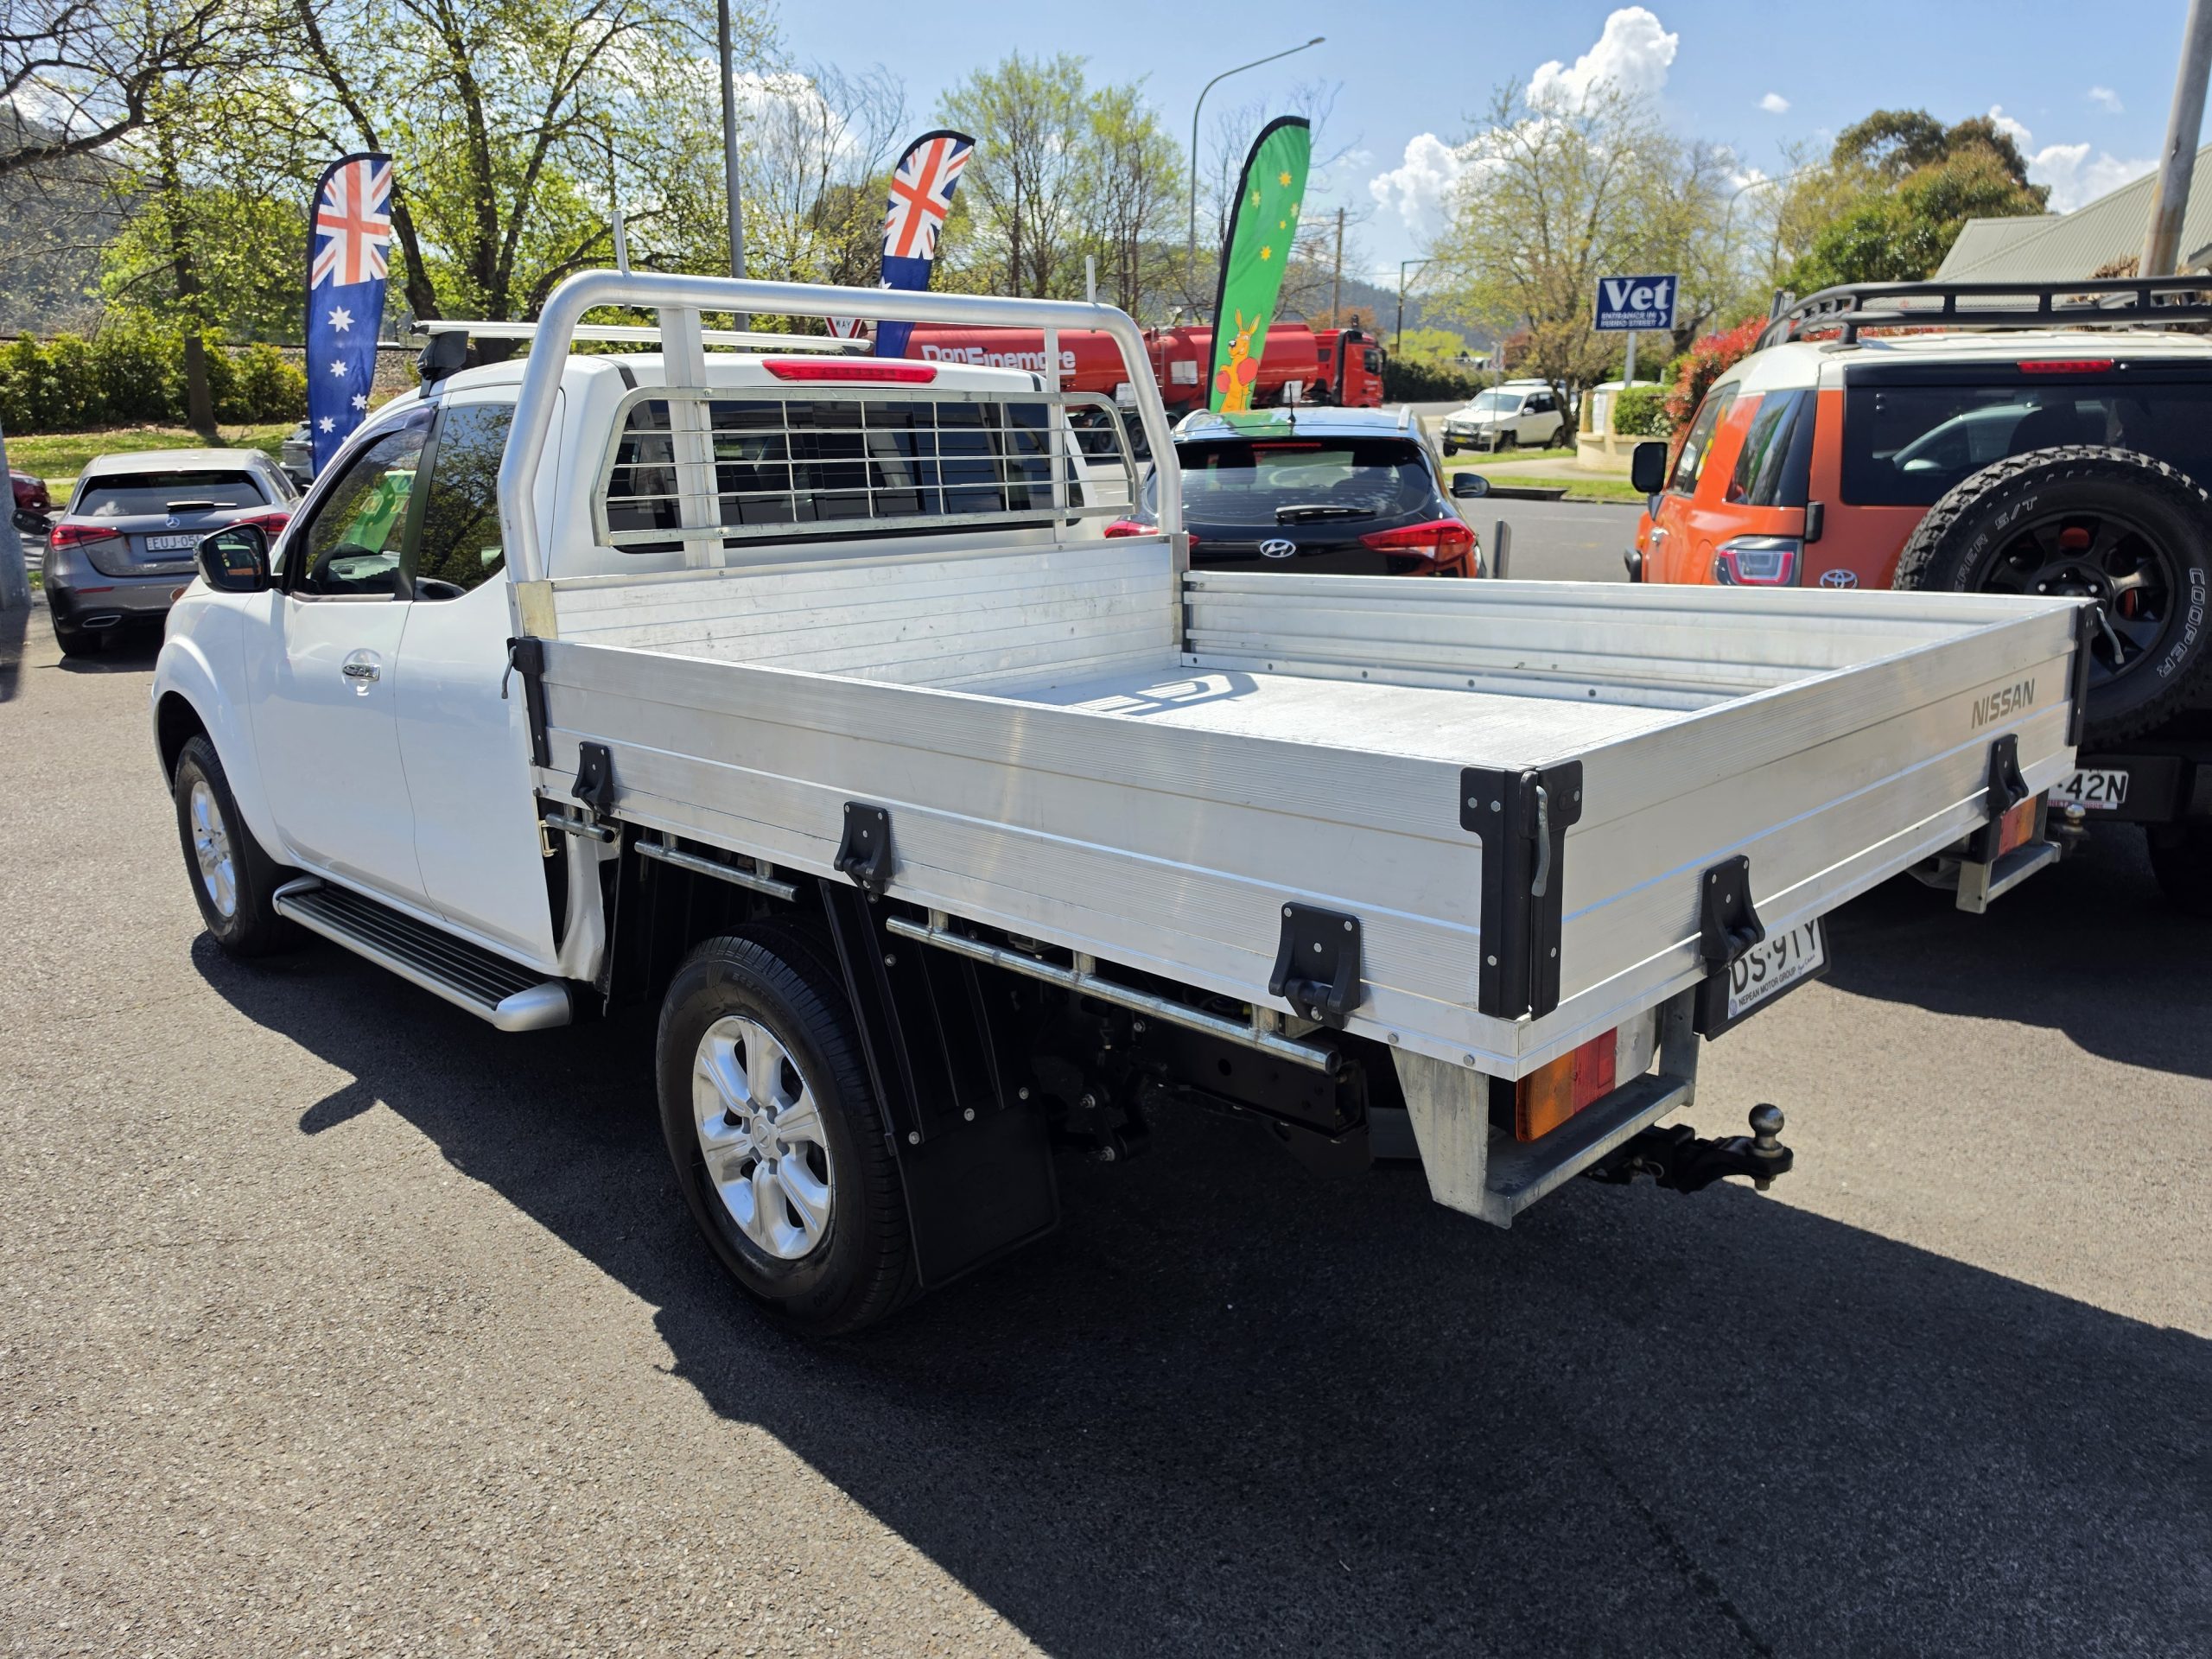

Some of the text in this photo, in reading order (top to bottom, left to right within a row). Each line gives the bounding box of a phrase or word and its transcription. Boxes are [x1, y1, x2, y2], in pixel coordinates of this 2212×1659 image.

[1603, 278, 1671, 311] Vet
[836, 320, 851, 328] WAY
[2156, 567, 2206, 678] COOPER
[1971, 677, 2035, 729] NISSAN
[1738, 988, 1760, 1007] NEPEAN
[1760, 977, 1779, 994] MOTOR
[1779, 966, 1796, 982] GROUP
